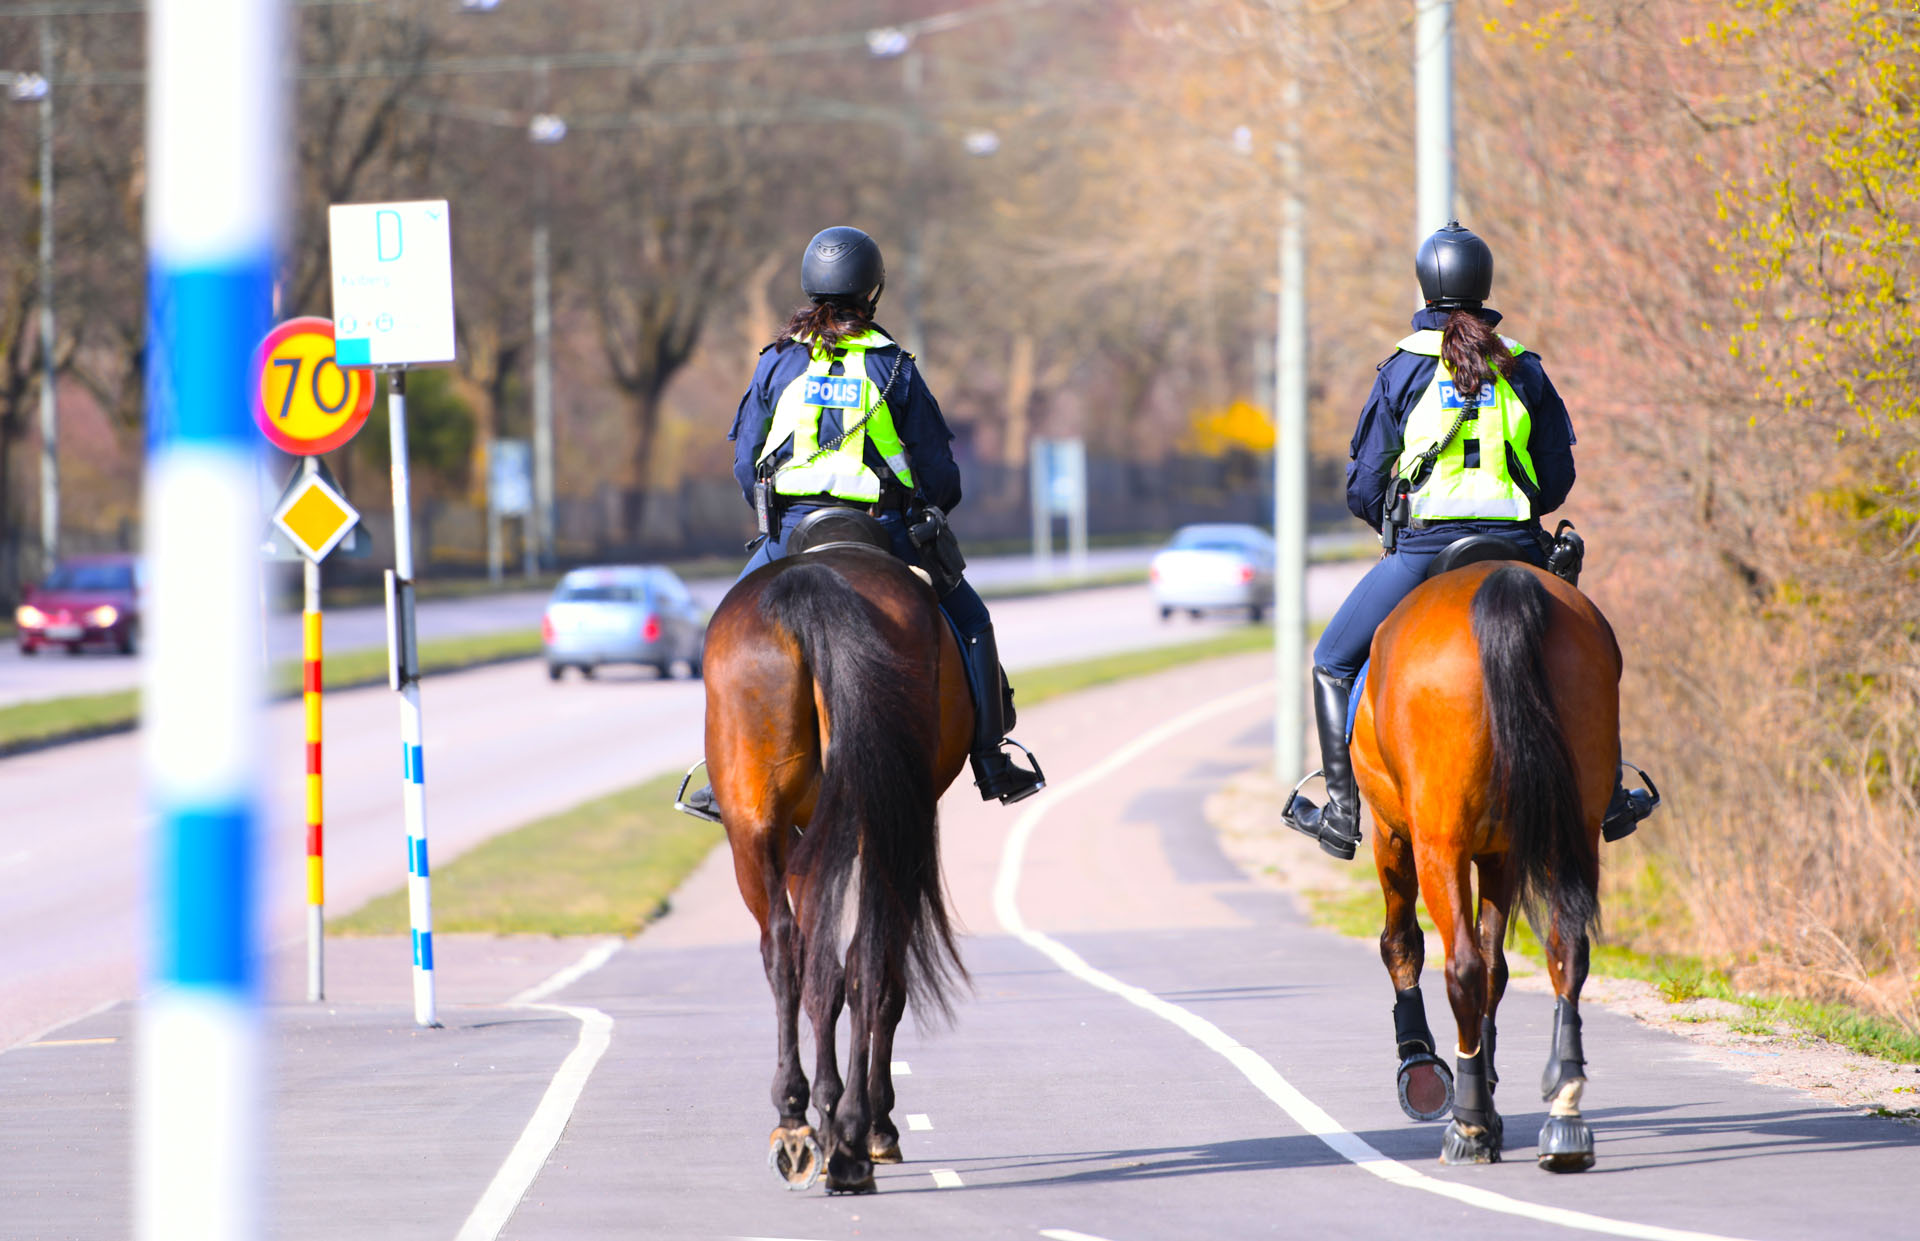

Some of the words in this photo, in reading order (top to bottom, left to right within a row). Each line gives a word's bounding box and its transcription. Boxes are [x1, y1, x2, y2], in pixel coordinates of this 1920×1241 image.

[376, 209, 403, 263] D
[273, 356, 351, 418] 70
[806, 380, 858, 402] POLIS
